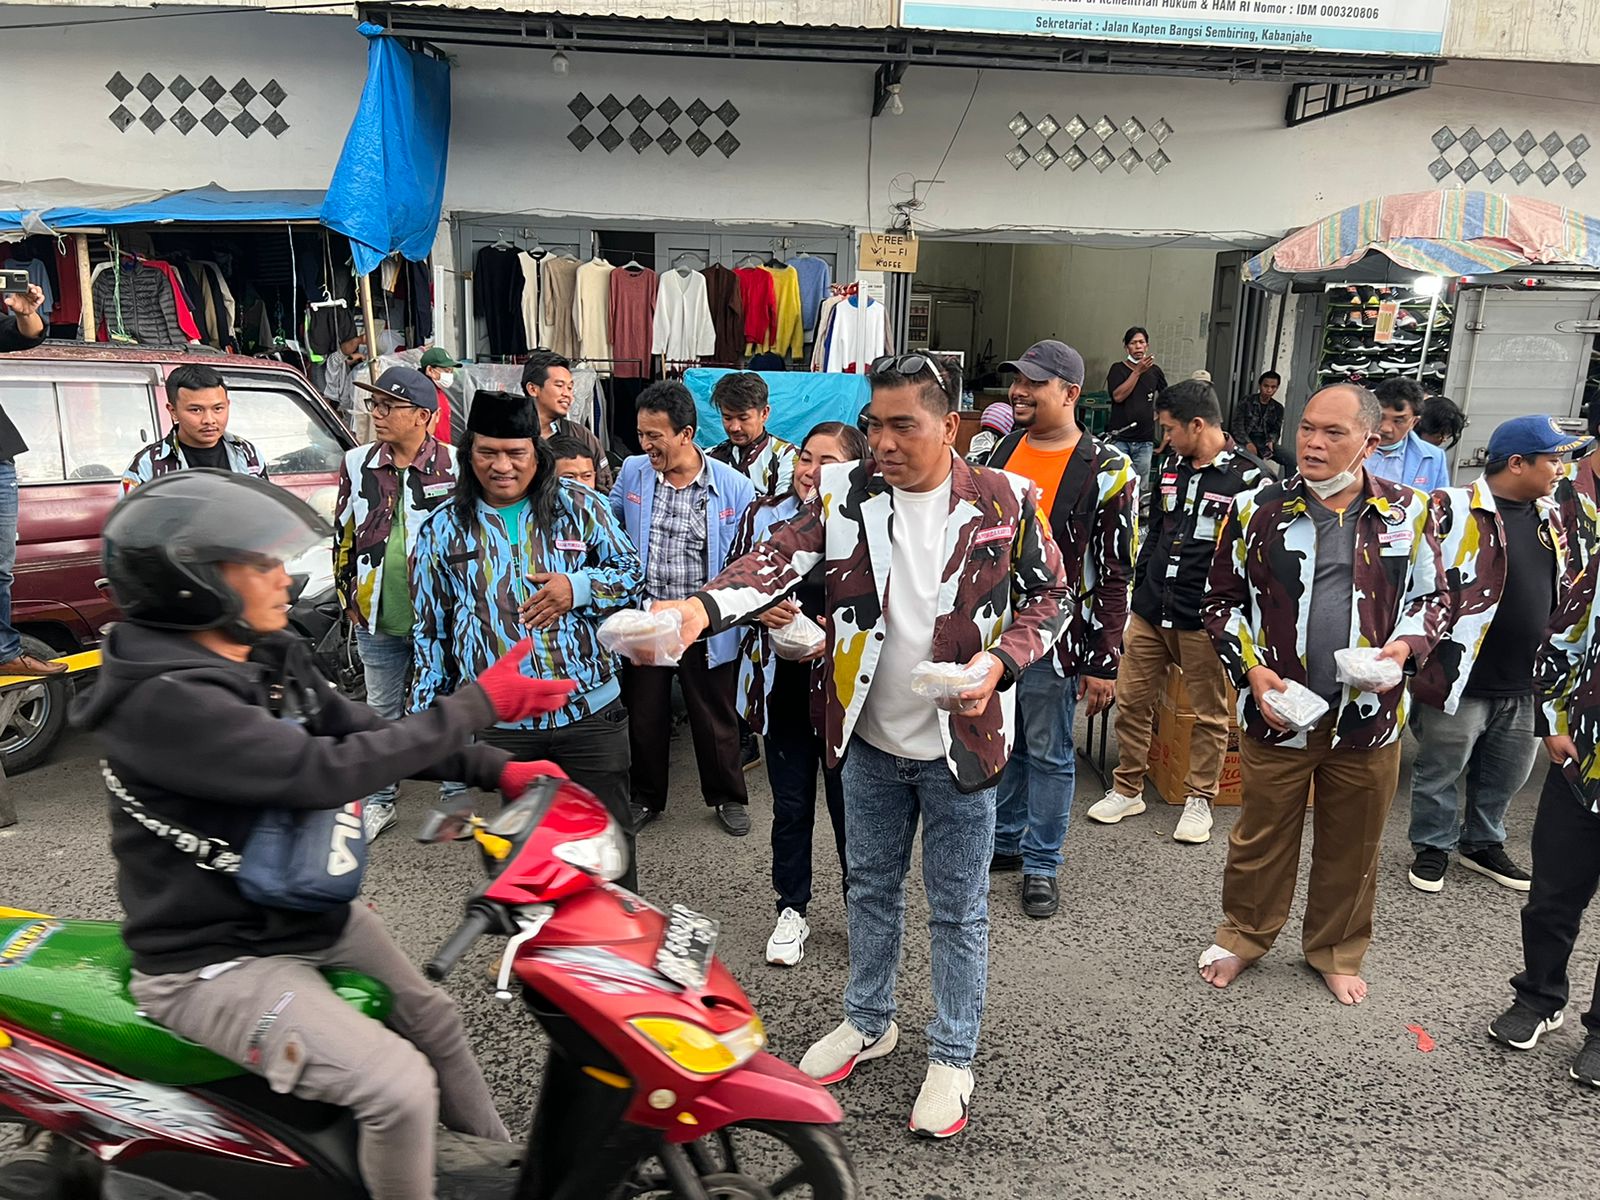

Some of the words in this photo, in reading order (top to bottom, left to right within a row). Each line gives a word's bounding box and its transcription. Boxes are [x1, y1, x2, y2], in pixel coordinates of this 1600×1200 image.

[1161, 0, 1197, 9] Hukum
[1200, 0, 1208, 10] &
[1212, 1, 1237, 12] HAM
[1239, 2, 1250, 12] RI
[1253, 2, 1287, 14] Nomor
[1296, 4, 1317, 15] IDM
[1320, 5, 1379, 19] 000320806
[1036, 16, 1092, 31] Sekretariat
[1102, 20, 1129, 33] Jalan
[1131, 22, 1166, 36] Kapten
[1169, 24, 1203, 39] Bangsi
[1205, 26, 1258, 42] Sembiring,
[1261, 29, 1312, 44] Kabanjahe
[877, 235, 903, 245] FREE
